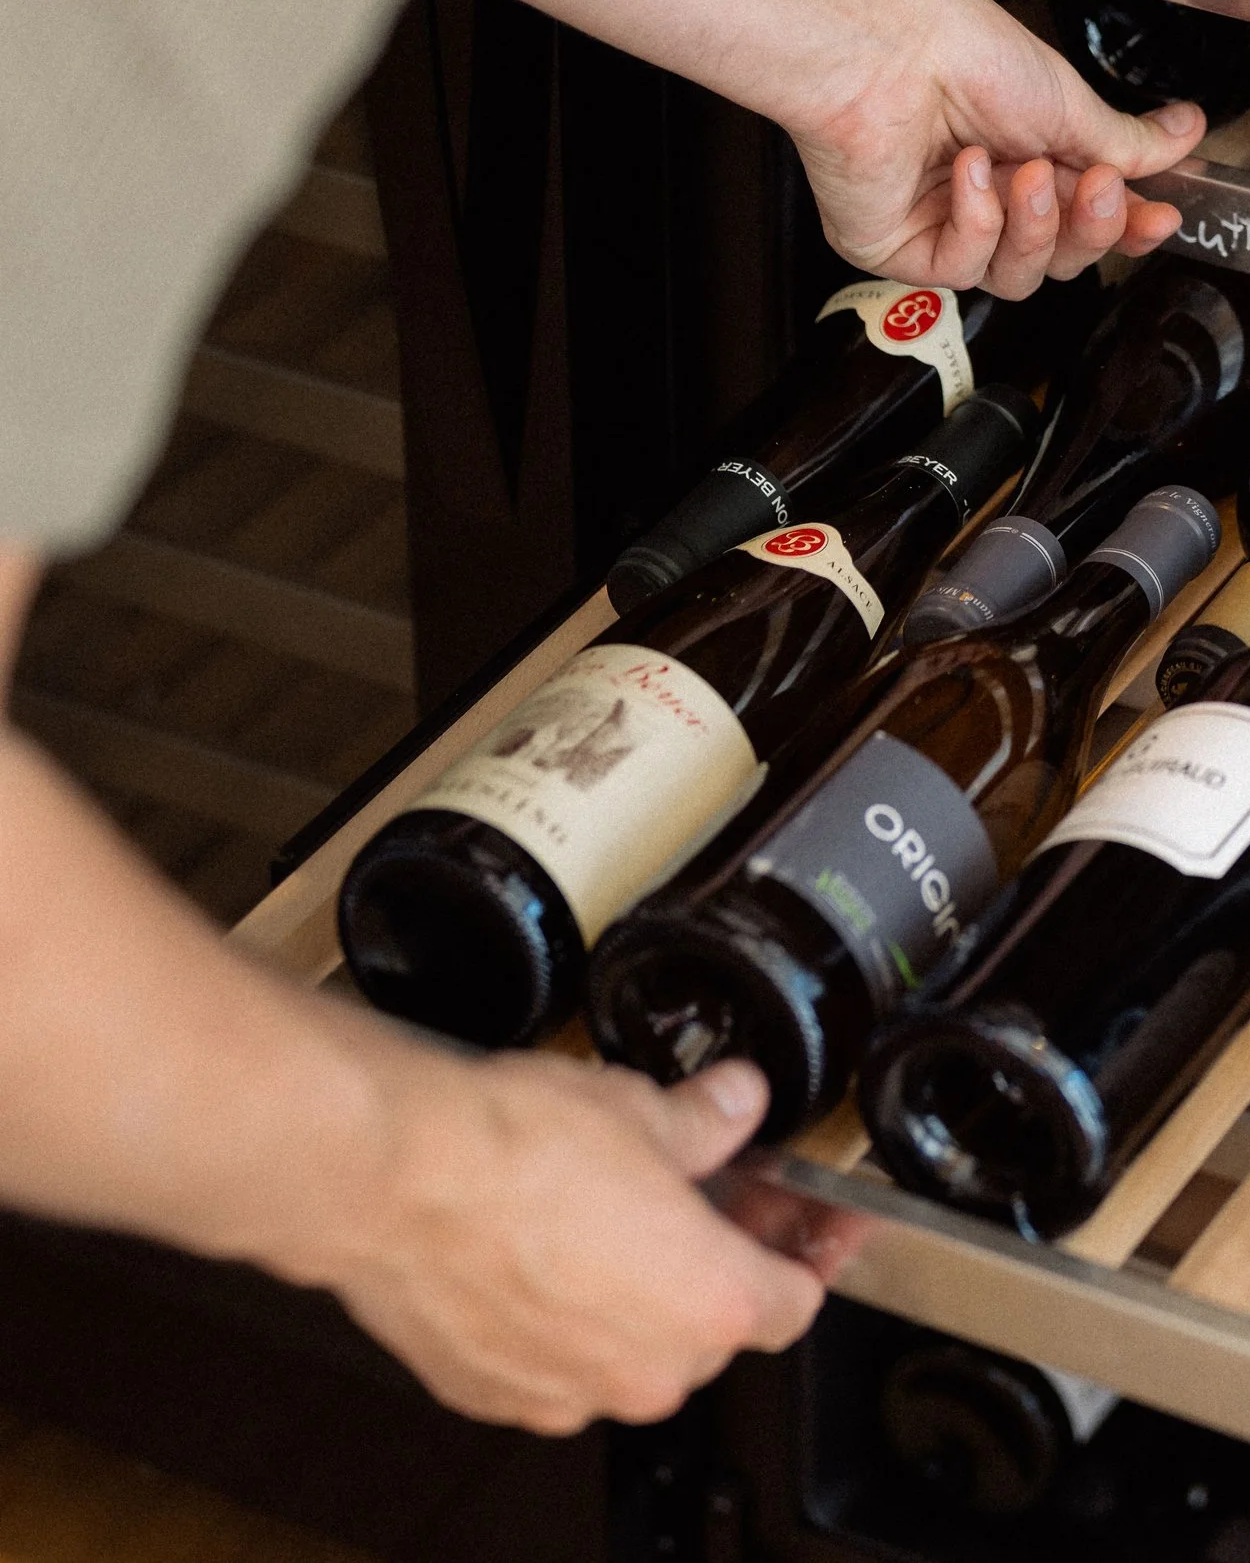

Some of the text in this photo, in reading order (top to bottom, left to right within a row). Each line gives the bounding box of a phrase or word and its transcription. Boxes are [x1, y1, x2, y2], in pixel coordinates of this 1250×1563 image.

[717, 461, 793, 529] ON BEYER
[826, 560, 873, 613] ALSACE
